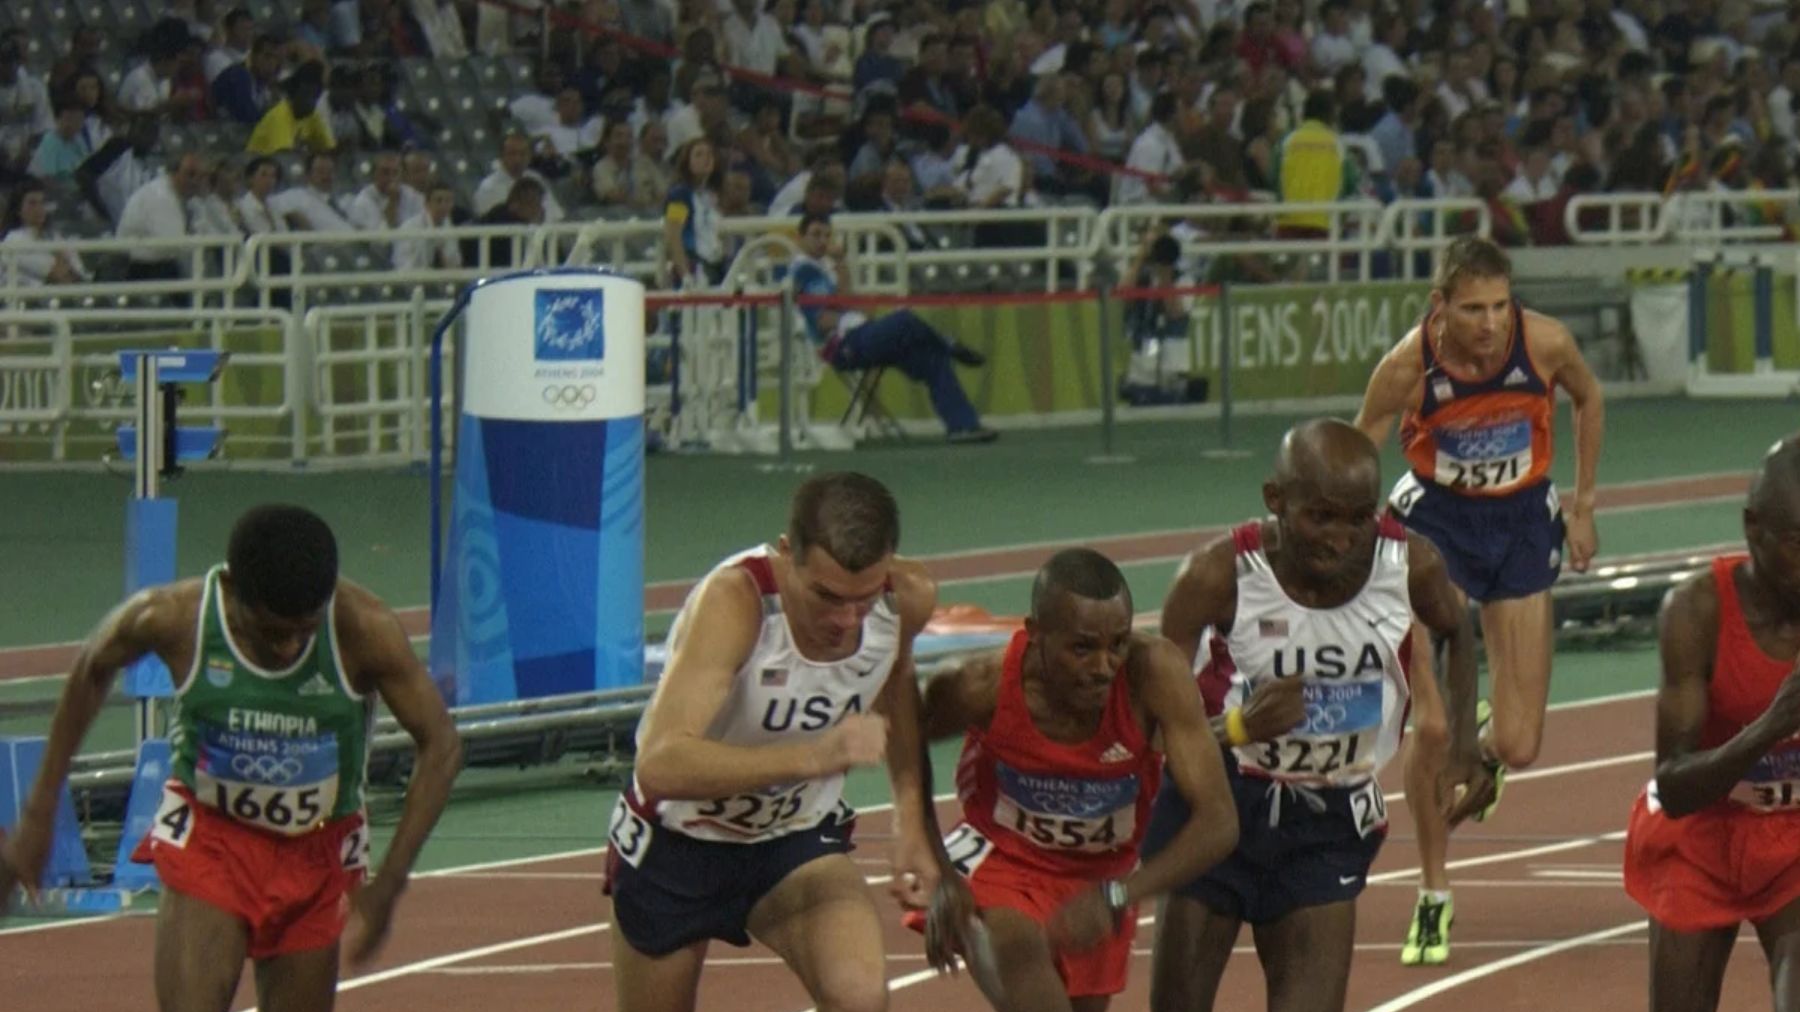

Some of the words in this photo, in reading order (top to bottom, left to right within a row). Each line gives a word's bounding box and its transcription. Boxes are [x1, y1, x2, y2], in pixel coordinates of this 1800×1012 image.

[1190, 302, 1300, 367] THENS
[1312, 296, 1393, 362] 2004
[1448, 457, 1518, 489] 2571
[1274, 643, 1383, 679] USA
[228, 707, 318, 736] ETHIOPIA
[762, 694, 862, 732] USA
[218, 733, 280, 752] ATHENS
[1257, 734, 1359, 773] 3221
[1018, 776, 1079, 793] ATHENS
[216, 783, 320, 827] 1665
[1015, 807, 1116, 848] 1554
